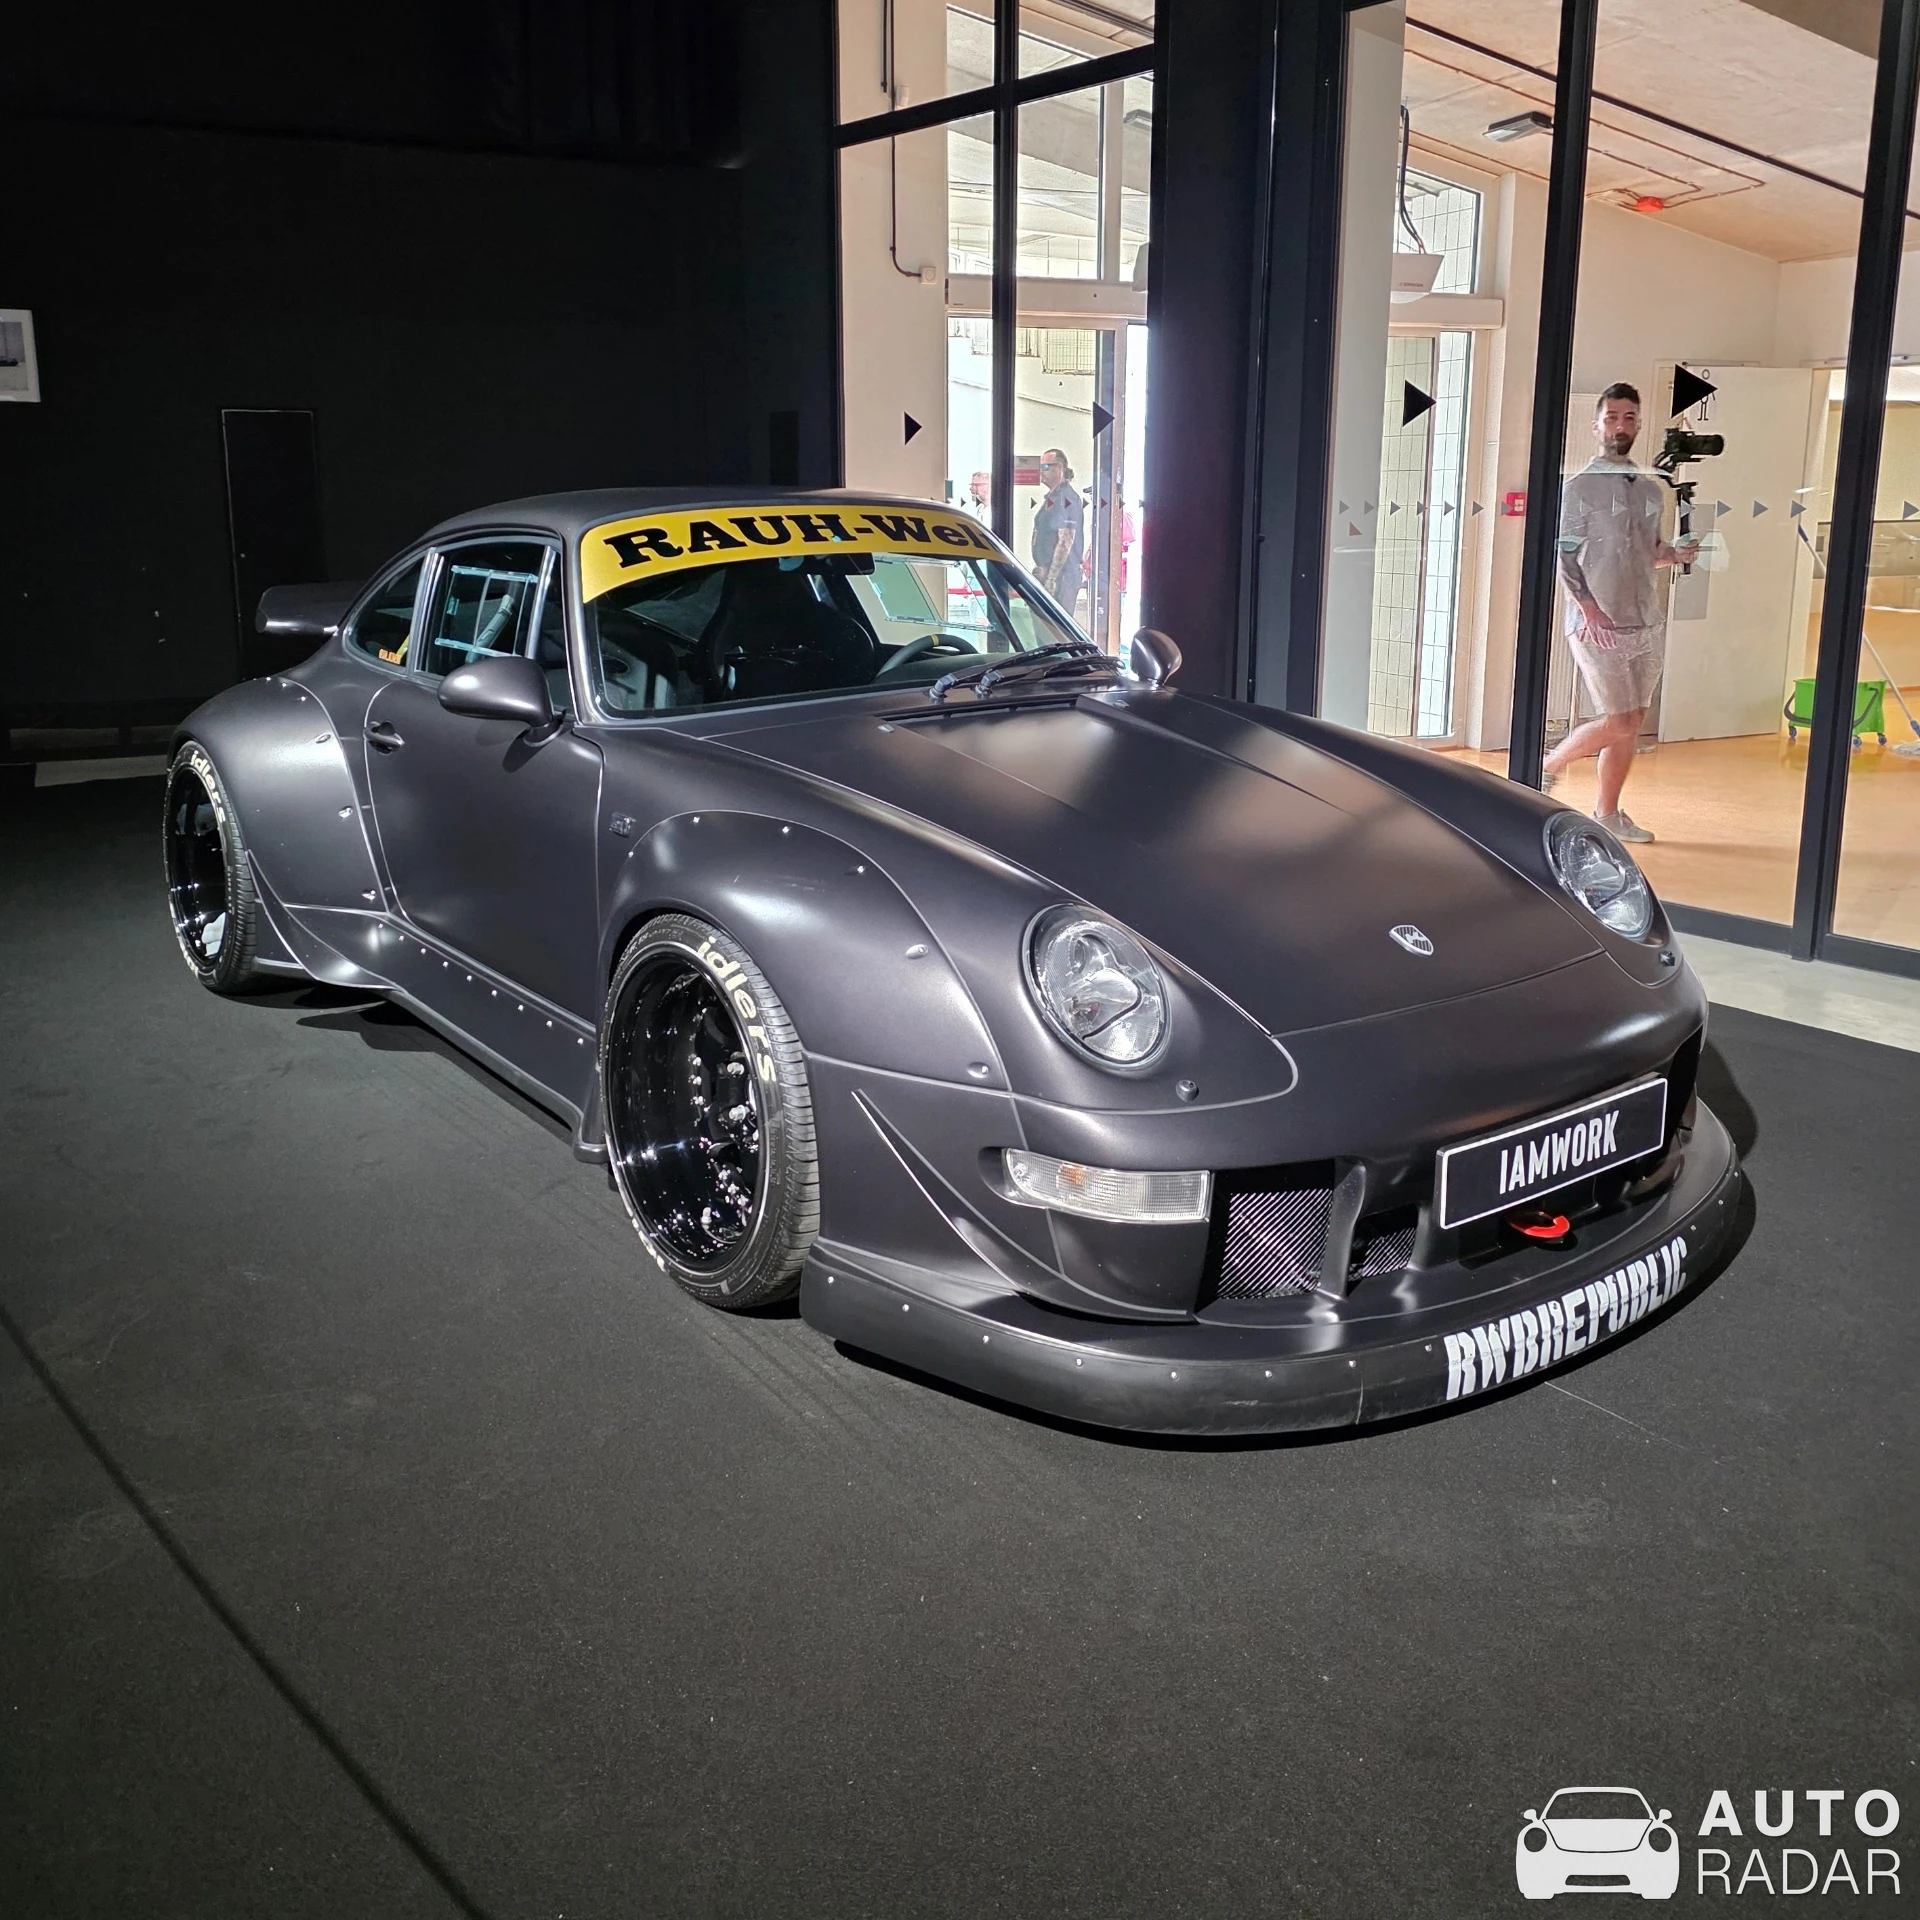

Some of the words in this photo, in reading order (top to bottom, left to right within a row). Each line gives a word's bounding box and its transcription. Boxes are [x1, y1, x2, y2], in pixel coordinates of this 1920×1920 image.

[190, 750, 226, 823] idlers
[698, 936, 776, 1082] idlers
[1499, 1110, 1620, 1194] IAMWORK
[1444, 1236, 1687, 1401] RWBREPUBLIC
